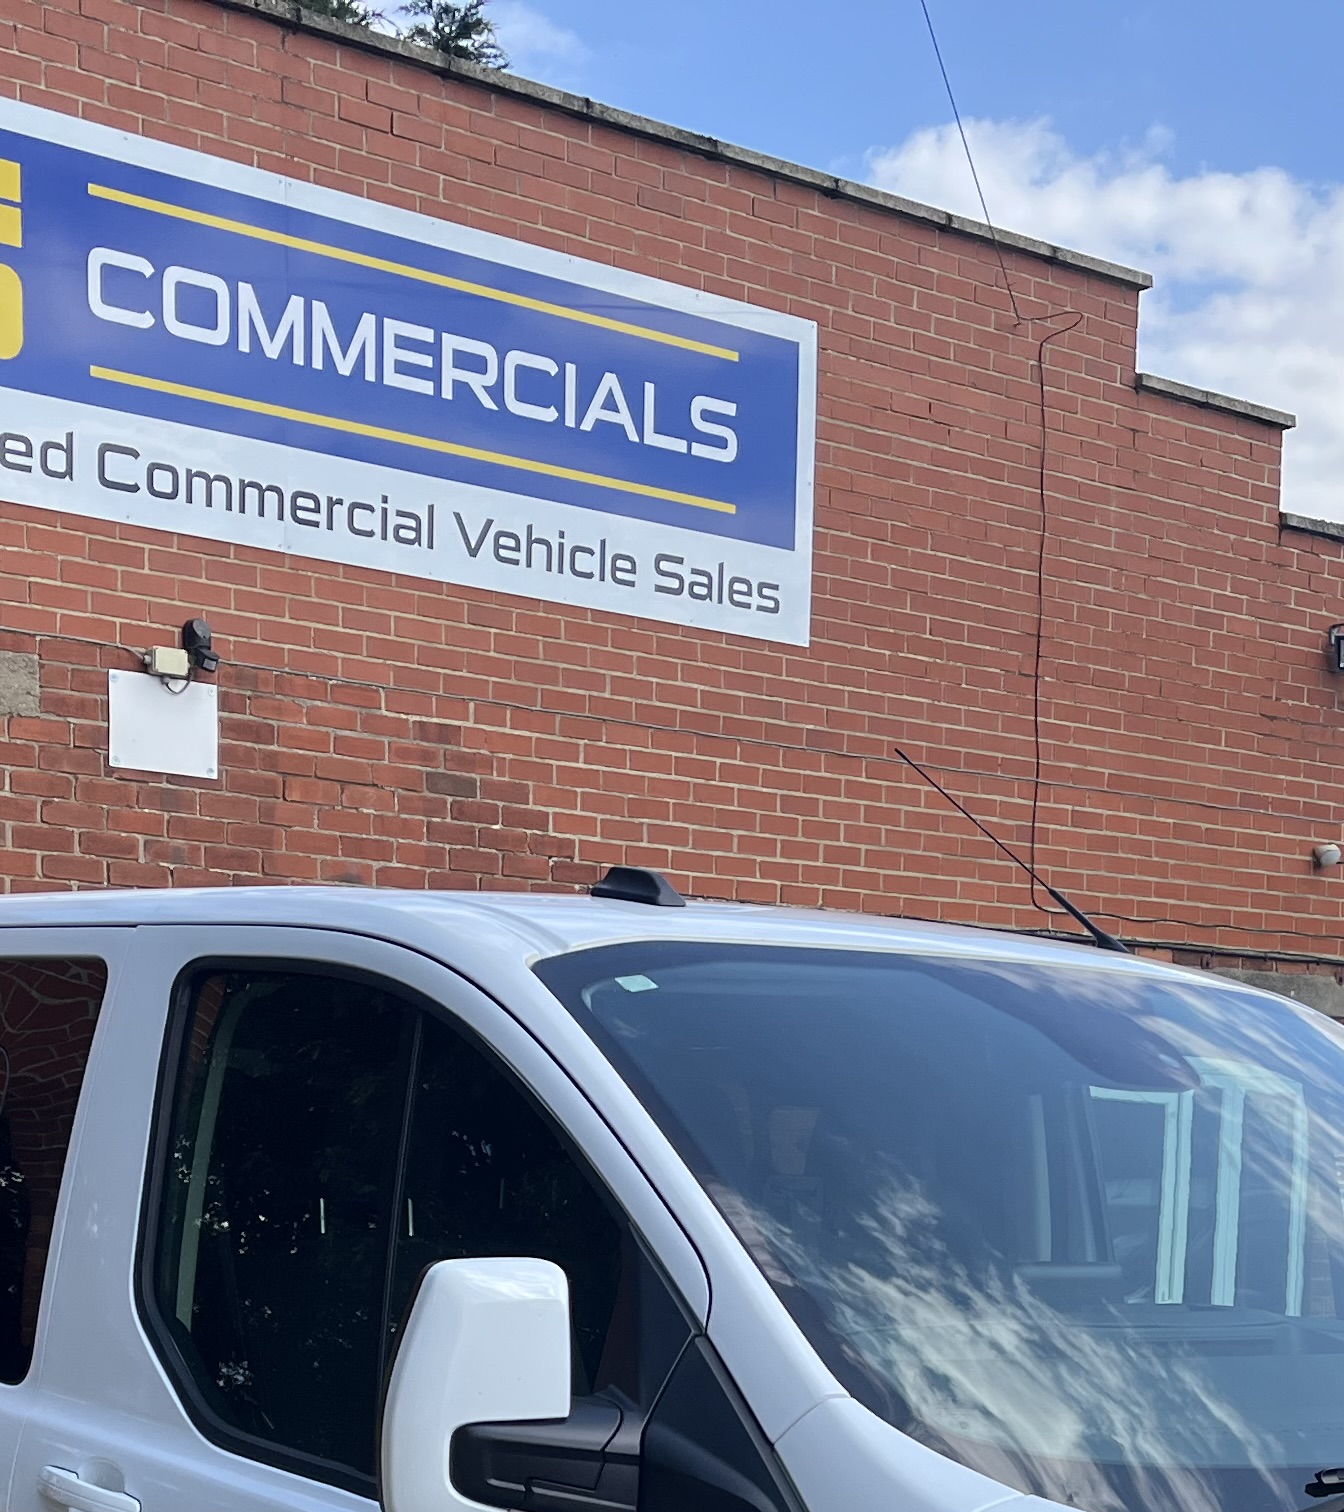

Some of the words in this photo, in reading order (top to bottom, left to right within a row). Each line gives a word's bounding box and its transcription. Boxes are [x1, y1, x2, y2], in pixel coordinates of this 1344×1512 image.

[87, 246, 739, 463] COMMERCIALS
[97, 441, 434, 550] Commercial
[453, 510, 638, 588] Vehicle
[653, 552, 781, 615] Sales
